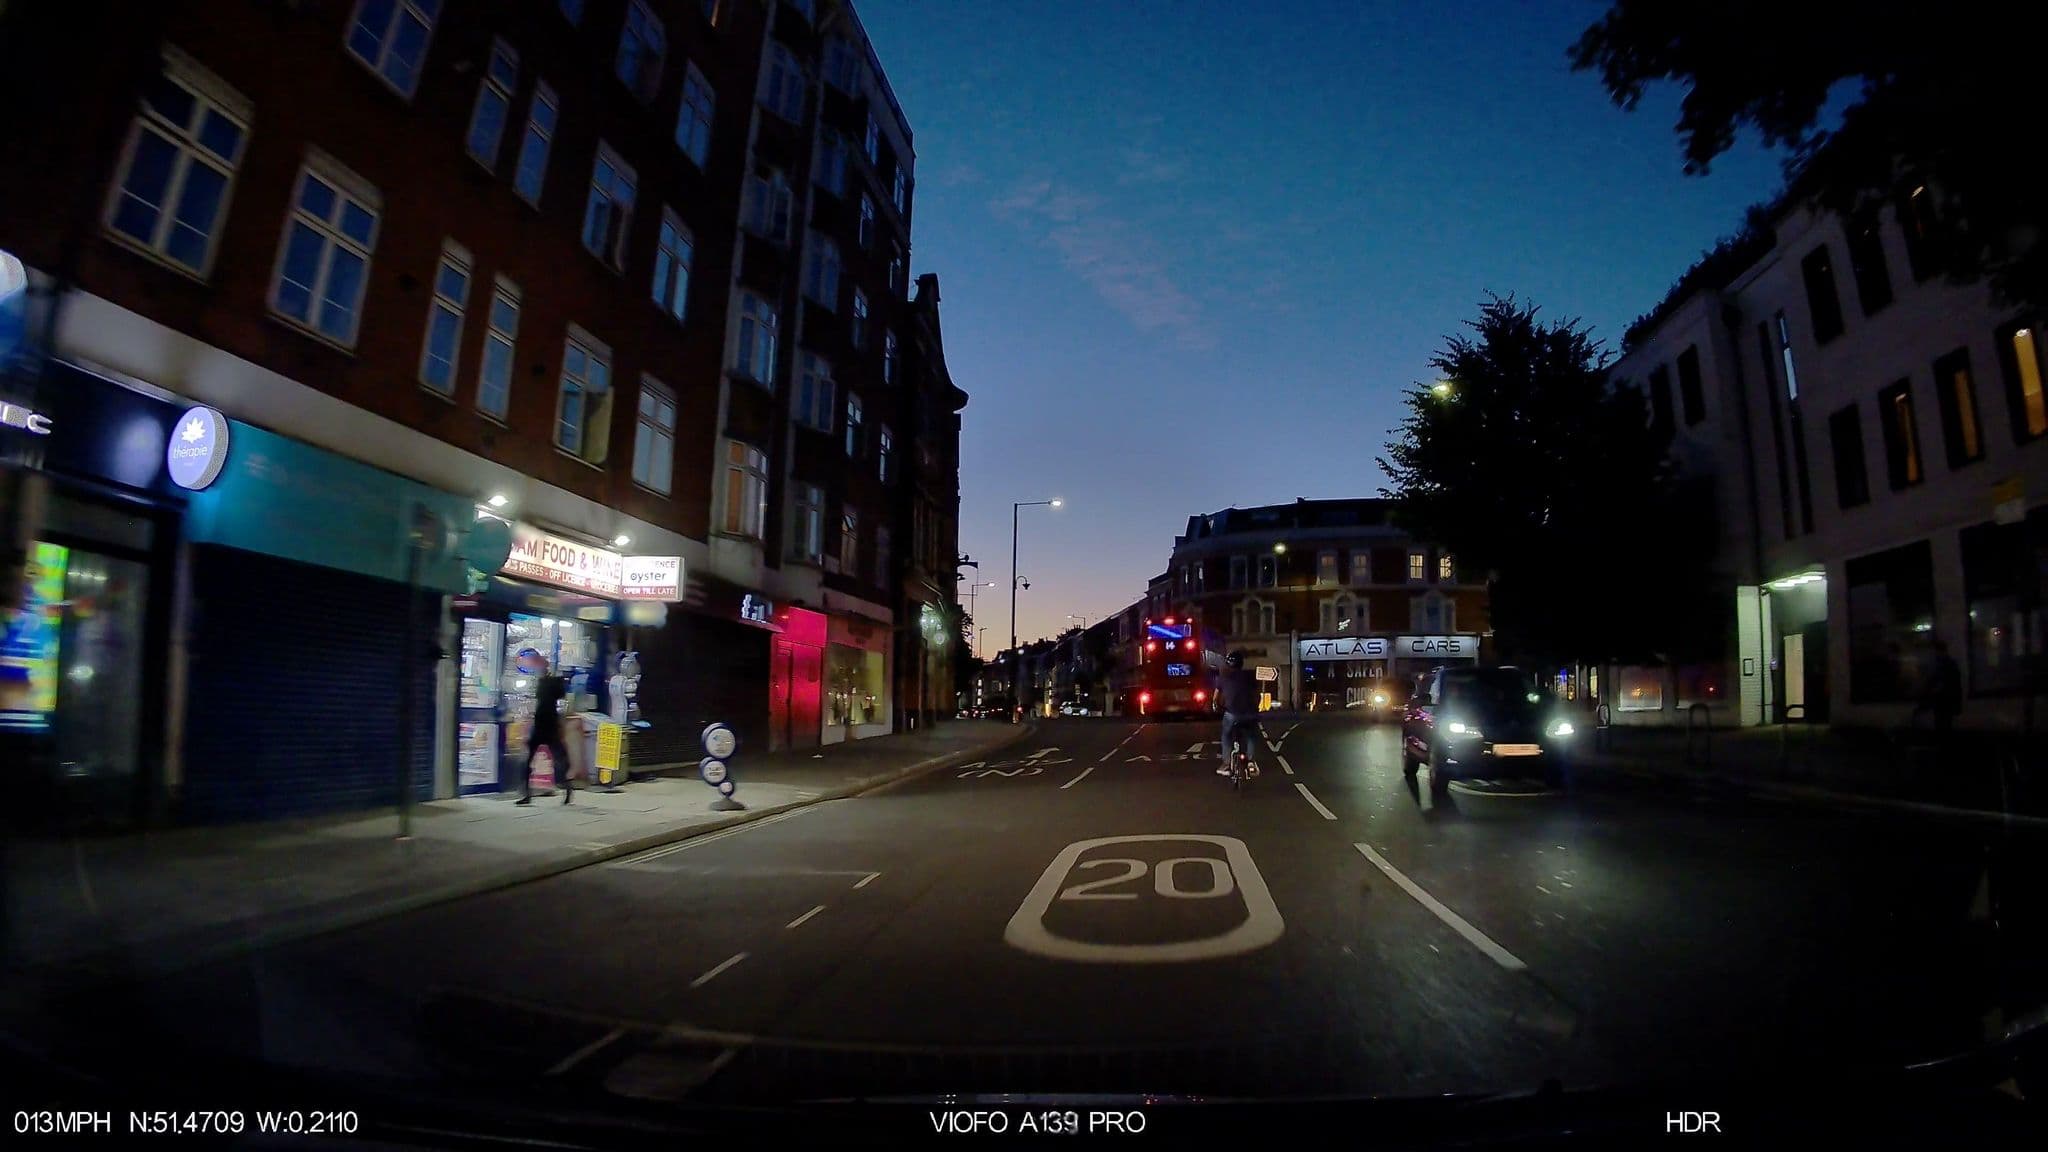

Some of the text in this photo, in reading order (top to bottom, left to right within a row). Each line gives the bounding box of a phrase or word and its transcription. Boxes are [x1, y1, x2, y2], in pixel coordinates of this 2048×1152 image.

[0, 402, 53, 434] IC
[512, 539, 538, 559] AM
[542, 540, 576, 567] FOOD
[580, 552, 588, 570] &
[519, 562, 544, 577] PASSES
[549, 570, 562, 581] OFF
[630, 571, 667, 583] oyster
[657, 587, 675, 595] LATE
[1306, 639, 1461, 657] ATLAS CARS
[1059, 857, 1235, 900] 20
